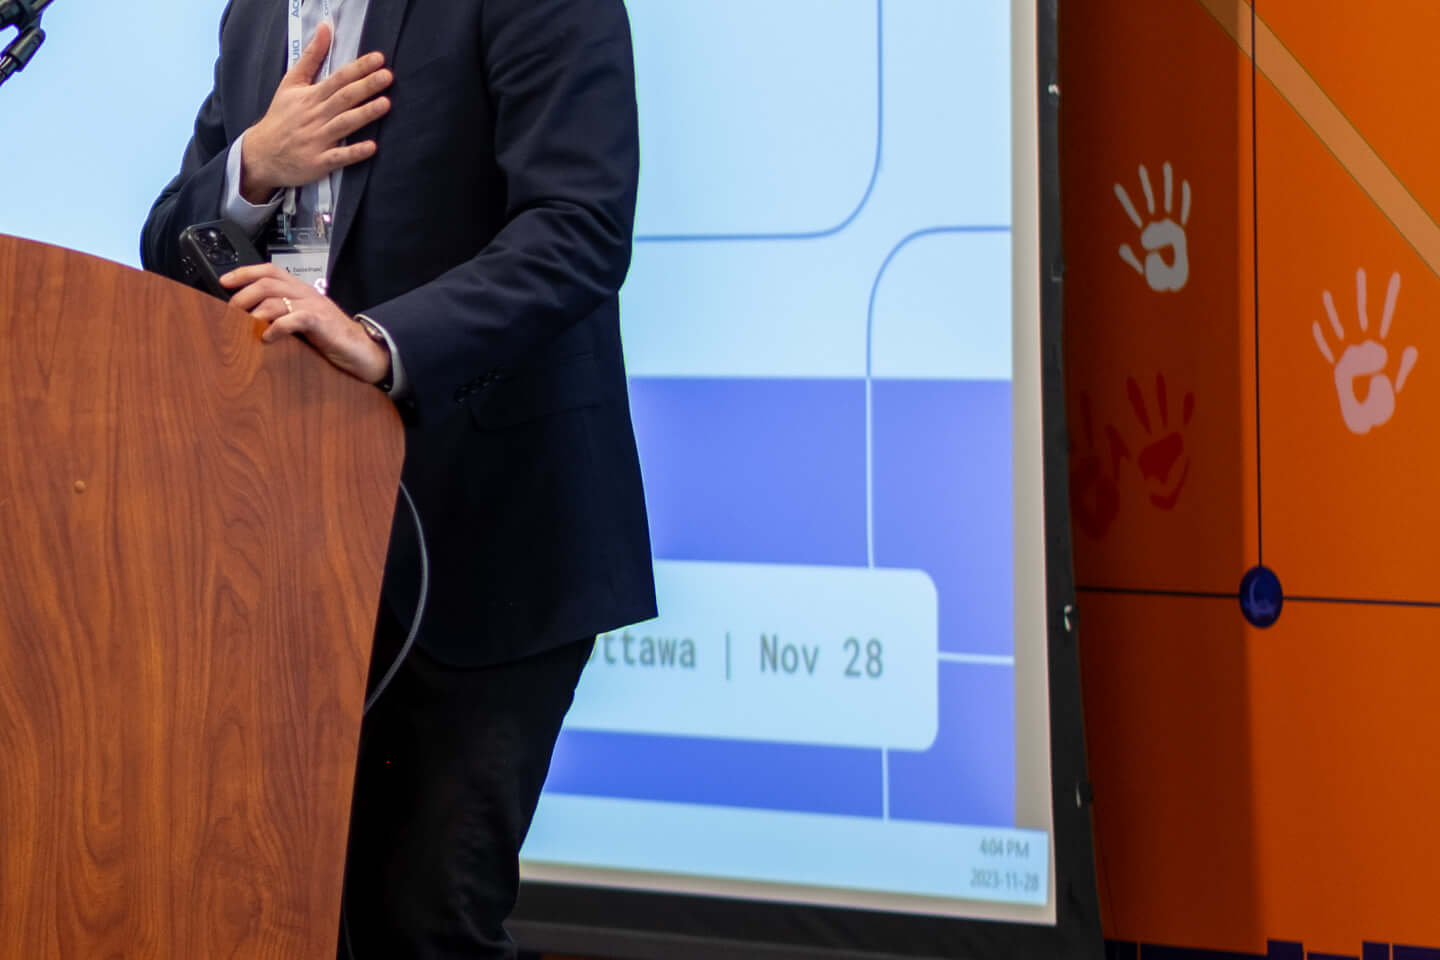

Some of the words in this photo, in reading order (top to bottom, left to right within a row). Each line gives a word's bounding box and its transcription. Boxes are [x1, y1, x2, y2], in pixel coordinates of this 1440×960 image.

[590, 631, 697, 669] ttawa
[759, 633, 820, 675] Nov
[843, 636, 884, 679] 28
[1007, 838, 1030, 859] PM
